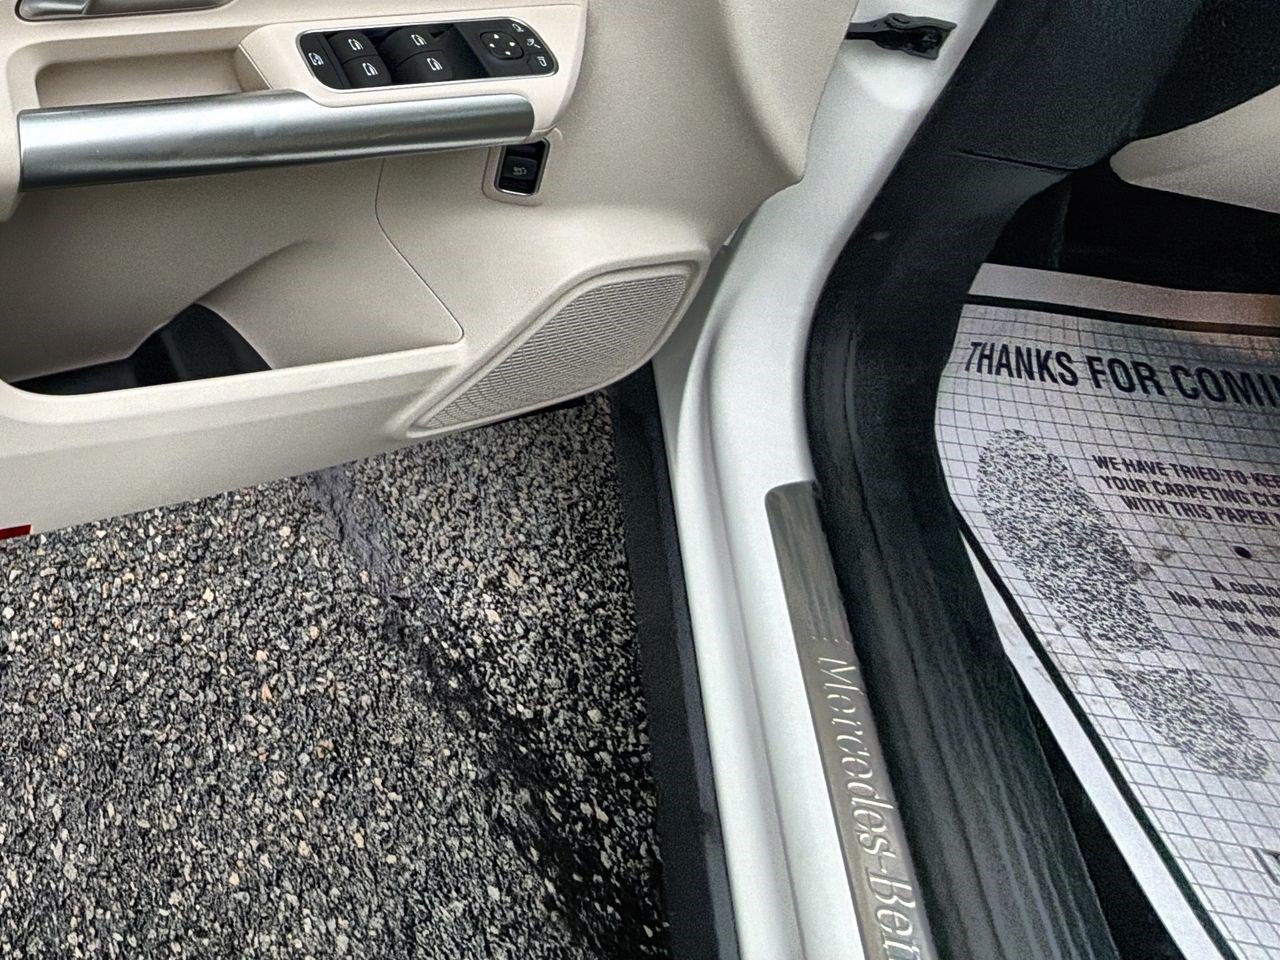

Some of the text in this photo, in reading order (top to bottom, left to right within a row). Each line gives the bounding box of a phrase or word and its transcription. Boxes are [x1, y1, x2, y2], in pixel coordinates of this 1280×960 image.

[966, 342, 1078, 387] THANKS
[1086, 356, 1167, 396] FOR
[1092, 455, 1121, 471] WE
[1122, 458, 1168, 476] HAVE
[1169, 463, 1220, 482] TRIED
[1222, 469, 1248, 485] TO
[1098, 476, 1152, 493] YOUR
[1152, 480, 1252, 504] CARPETING
[1120, 495, 1170, 514] WITH
[1170, 501, 1213, 520] THIS
[1214, 506, 1274, 526] PAPER
[1167, 590, 1201, 608] the
[1204, 598, 1253, 614] most
